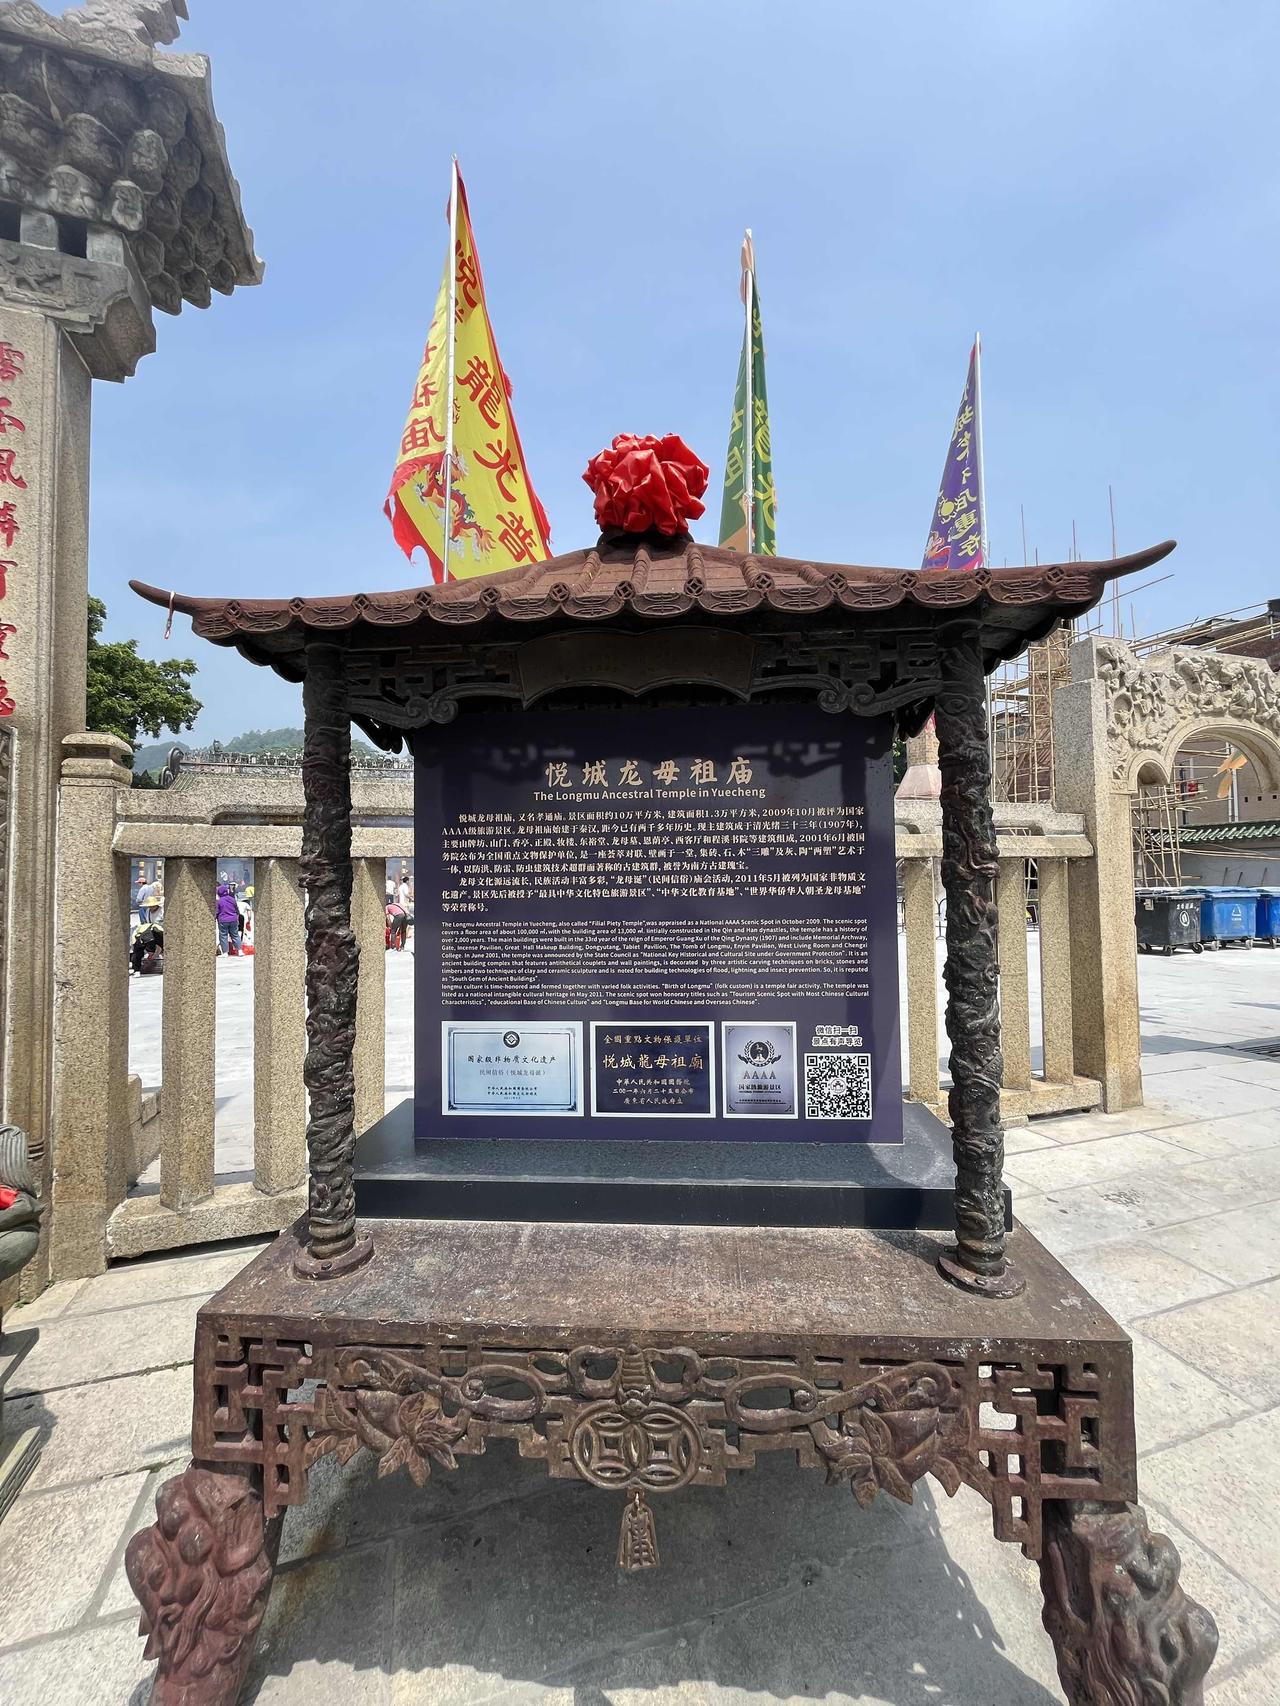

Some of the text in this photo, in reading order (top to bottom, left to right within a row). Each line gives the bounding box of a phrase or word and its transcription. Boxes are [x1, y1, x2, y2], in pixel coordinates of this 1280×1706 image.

[544, 756, 753, 788] 悦城龙母祖庙
[534, 787, 766, 802] The Longmu Ancestral Temple in Yuecheng
[442, 902, 489, 912] 等荣誉称号。
[658, 919, 686, 927] appraised
[572, 928, 595, 936] building
[840, 926, 859, 934] history
[513, 936, 538, 944] buildings
[628, 935, 642, 943] reign
[651, 935, 674, 943] Emperor
[676, 935, 694, 943] Guang
[841, 934, 868, 942] Archway,
[707, 943, 732, 951] Longmu,
[463, 960, 485, 968] building
[634, 959, 661, 967] paintings,
[486, 967, 516, 975] techniques
[571, 967, 596, 975] sculpture
[644, 967, 667, 975] building
[845, 966, 868, 974] reputed
[835, 982, 855, 990] temple
[494, 991, 520, 999] intangible
[546, 991, 568, 999] heritage
[816, 1025, 858, 1035] 微信扫一扫
[812, 1037, 863, 1047] 景点有声导览
